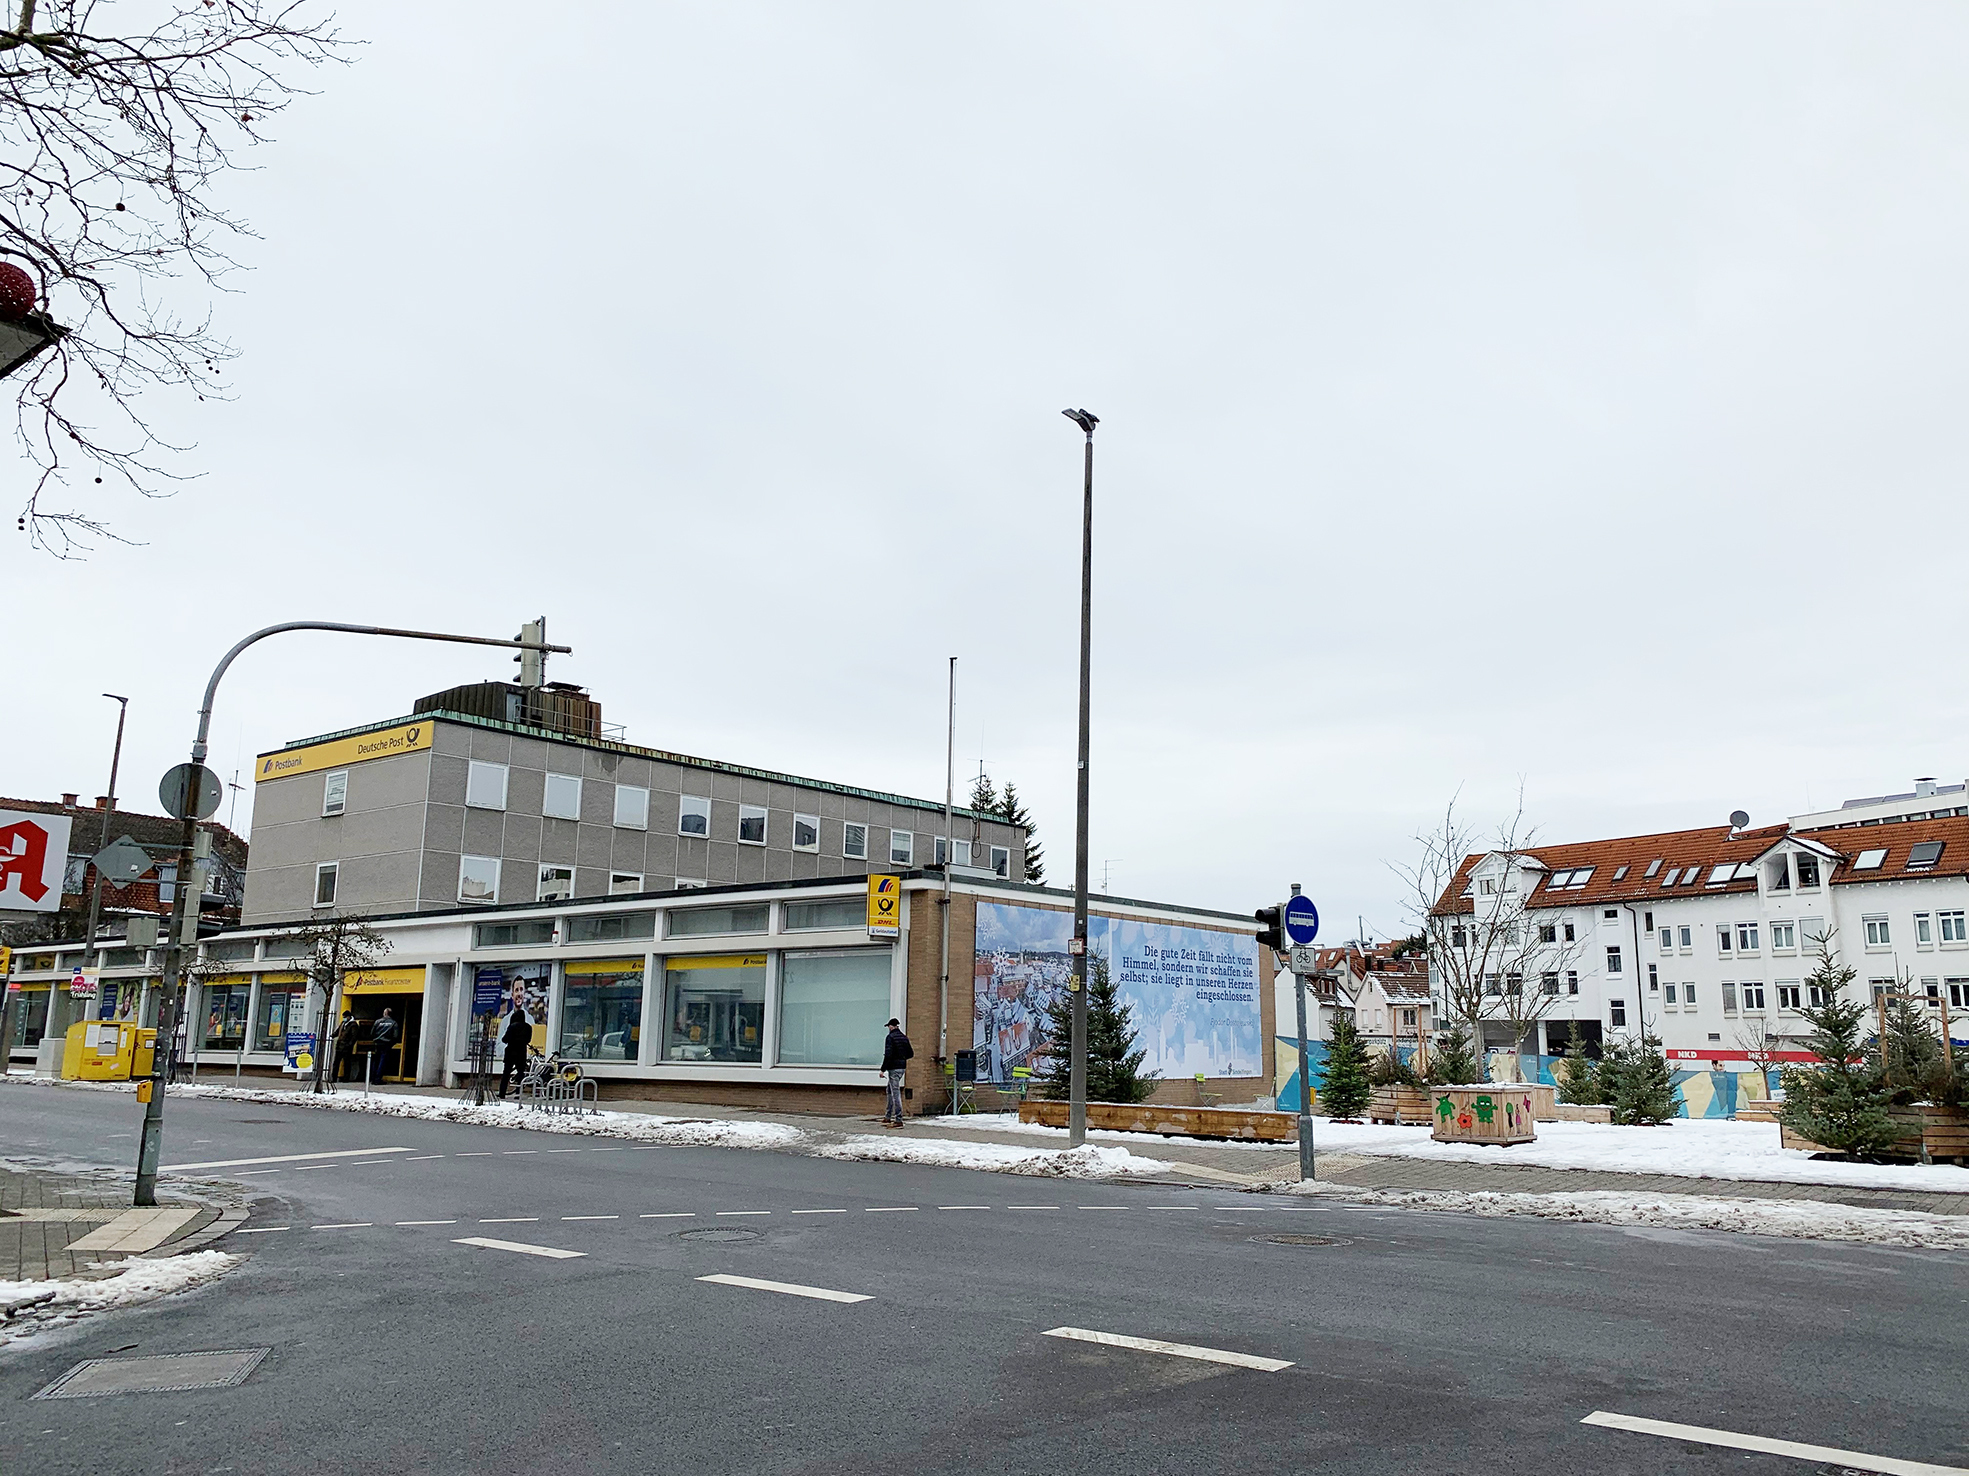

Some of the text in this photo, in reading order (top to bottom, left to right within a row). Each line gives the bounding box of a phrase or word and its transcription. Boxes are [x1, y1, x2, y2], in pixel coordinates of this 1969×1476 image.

[358, 737, 404, 754] Deutsche Post
[275, 755, 303, 770] Postbank
[1144, 945, 1253, 965] Die gute Zeit fällt nicht vom
[1122, 956, 1253, 978] Himmel, sondern wir schaffen sie
[1120, 971, 1253, 990] selbst; sie liegt in unseren Herzen
[1196, 989, 1254, 1003] eingeschlossen.
[1678, 1051, 1698, 1059] NKD
